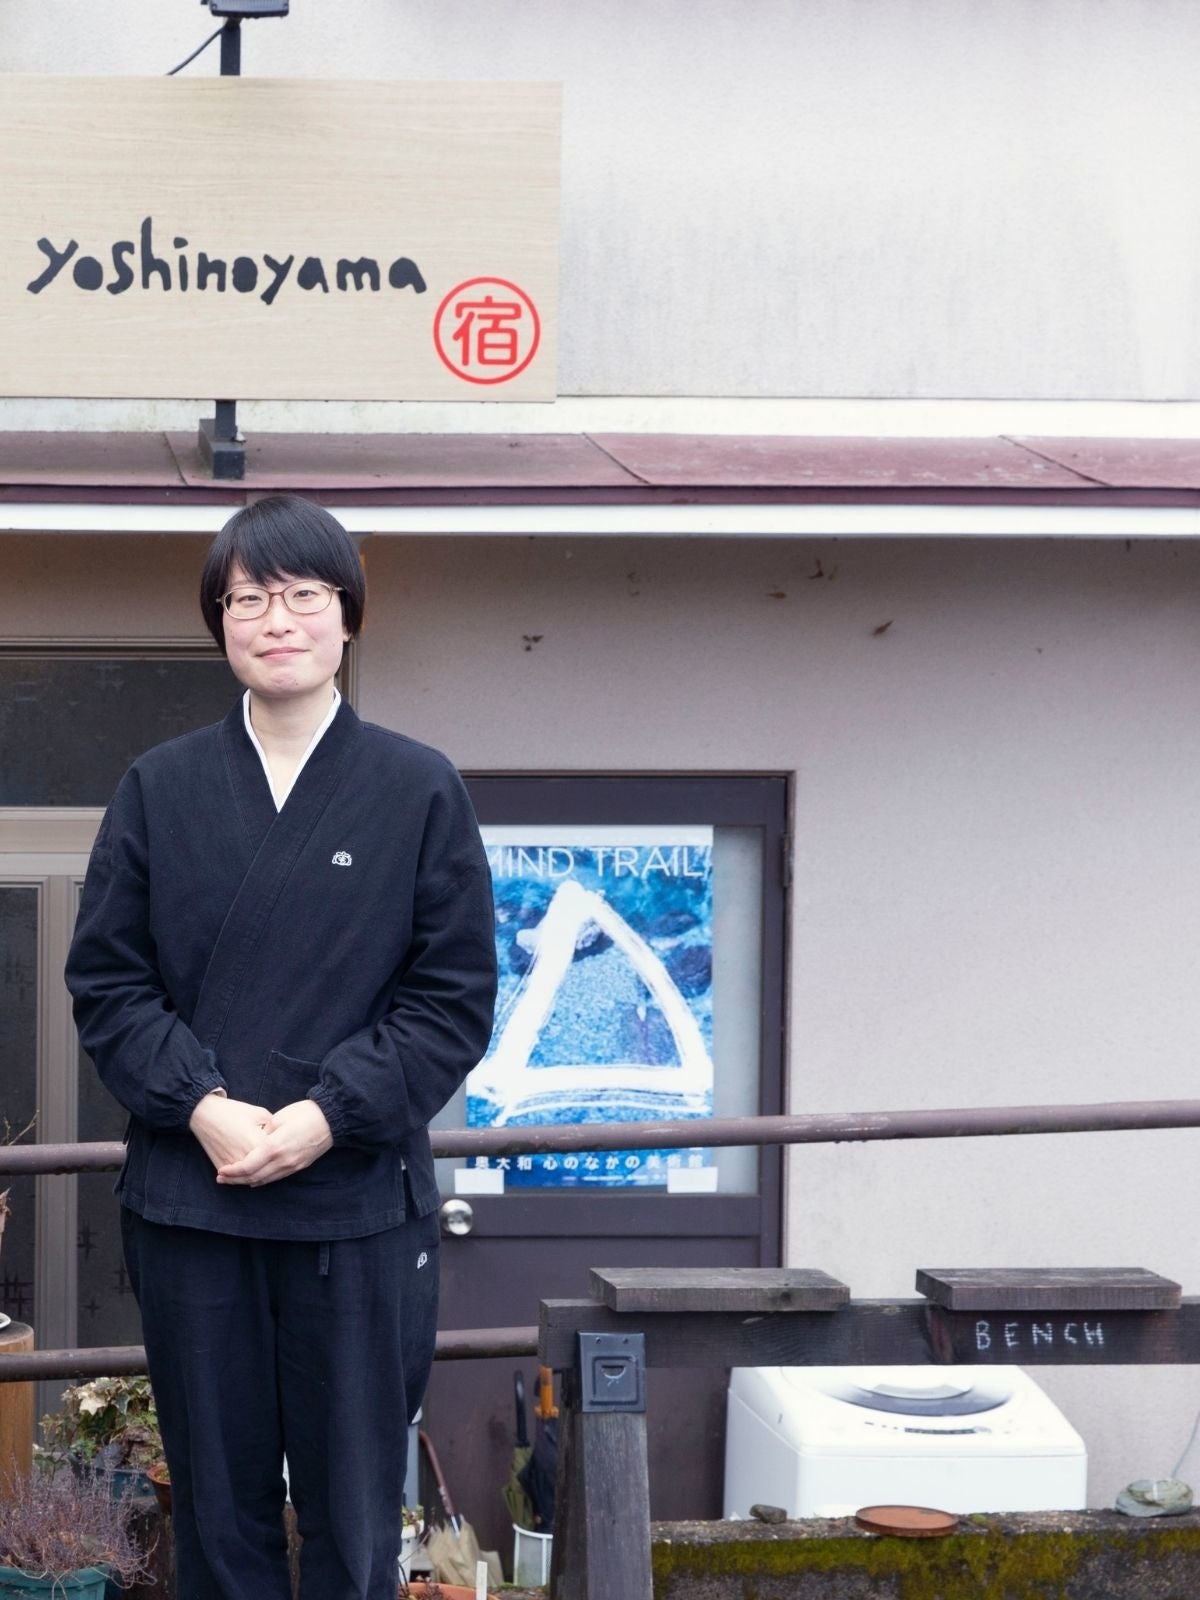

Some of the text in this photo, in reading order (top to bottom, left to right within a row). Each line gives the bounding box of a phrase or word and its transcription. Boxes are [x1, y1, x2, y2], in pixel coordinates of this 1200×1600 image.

[26, 216, 427, 306] yoshinoyama
[452, 295, 523, 367] 宿
[589, 847, 704, 878] TRAIL
[975, 1320, 1105, 1350] BENCH
